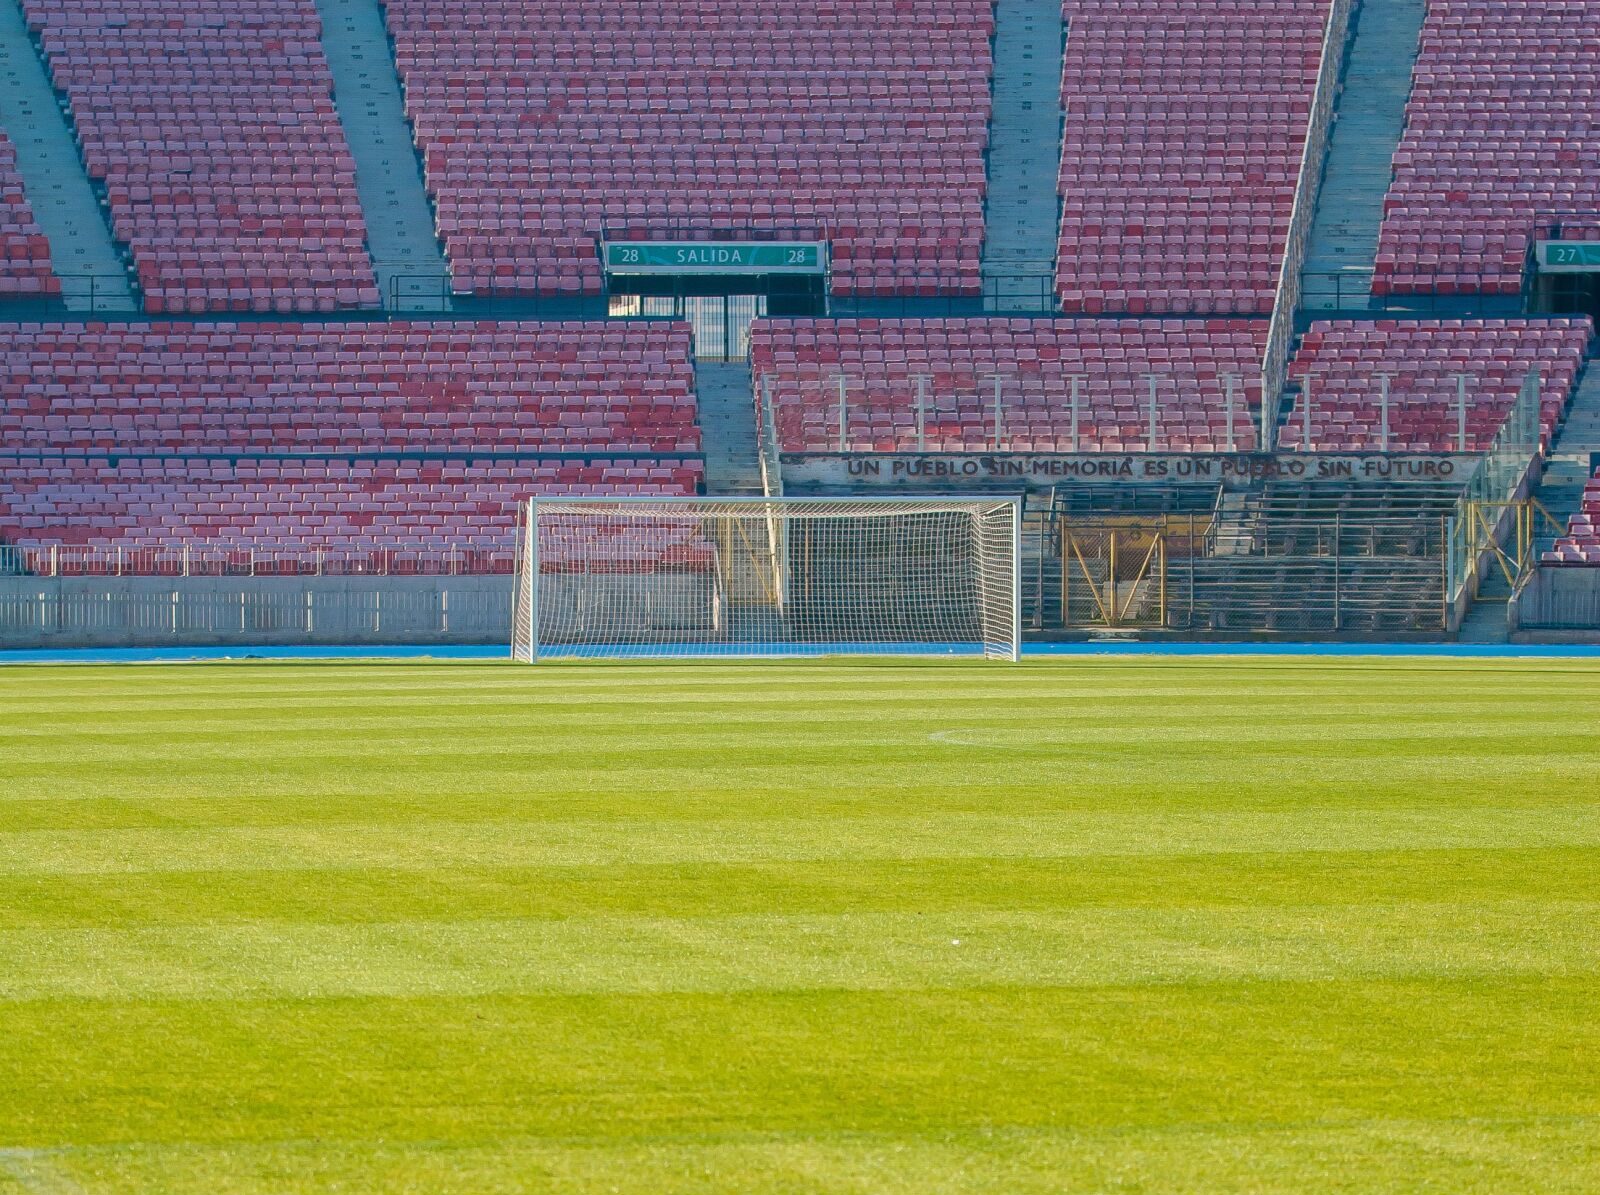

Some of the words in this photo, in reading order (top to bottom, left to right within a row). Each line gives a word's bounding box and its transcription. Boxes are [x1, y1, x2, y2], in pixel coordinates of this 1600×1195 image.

[622, 250, 639, 262] 28
[677, 250, 742, 262] SALIDA
[788, 250, 805, 262] 28
[1557, 249, 1577, 262] 27
[848, 461, 880, 476] UN
[893, 461, 979, 476] PUEBLO
[988, 461, 1023, 476] SIN
[1032, 461, 1133, 476] MEMORIA
[1145, 461, 1168, 476] ES
[1177, 461, 1211, 476] UN
[1317, 461, 1352, 476] SIN
[1364, 461, 1454, 476] FUTURO
